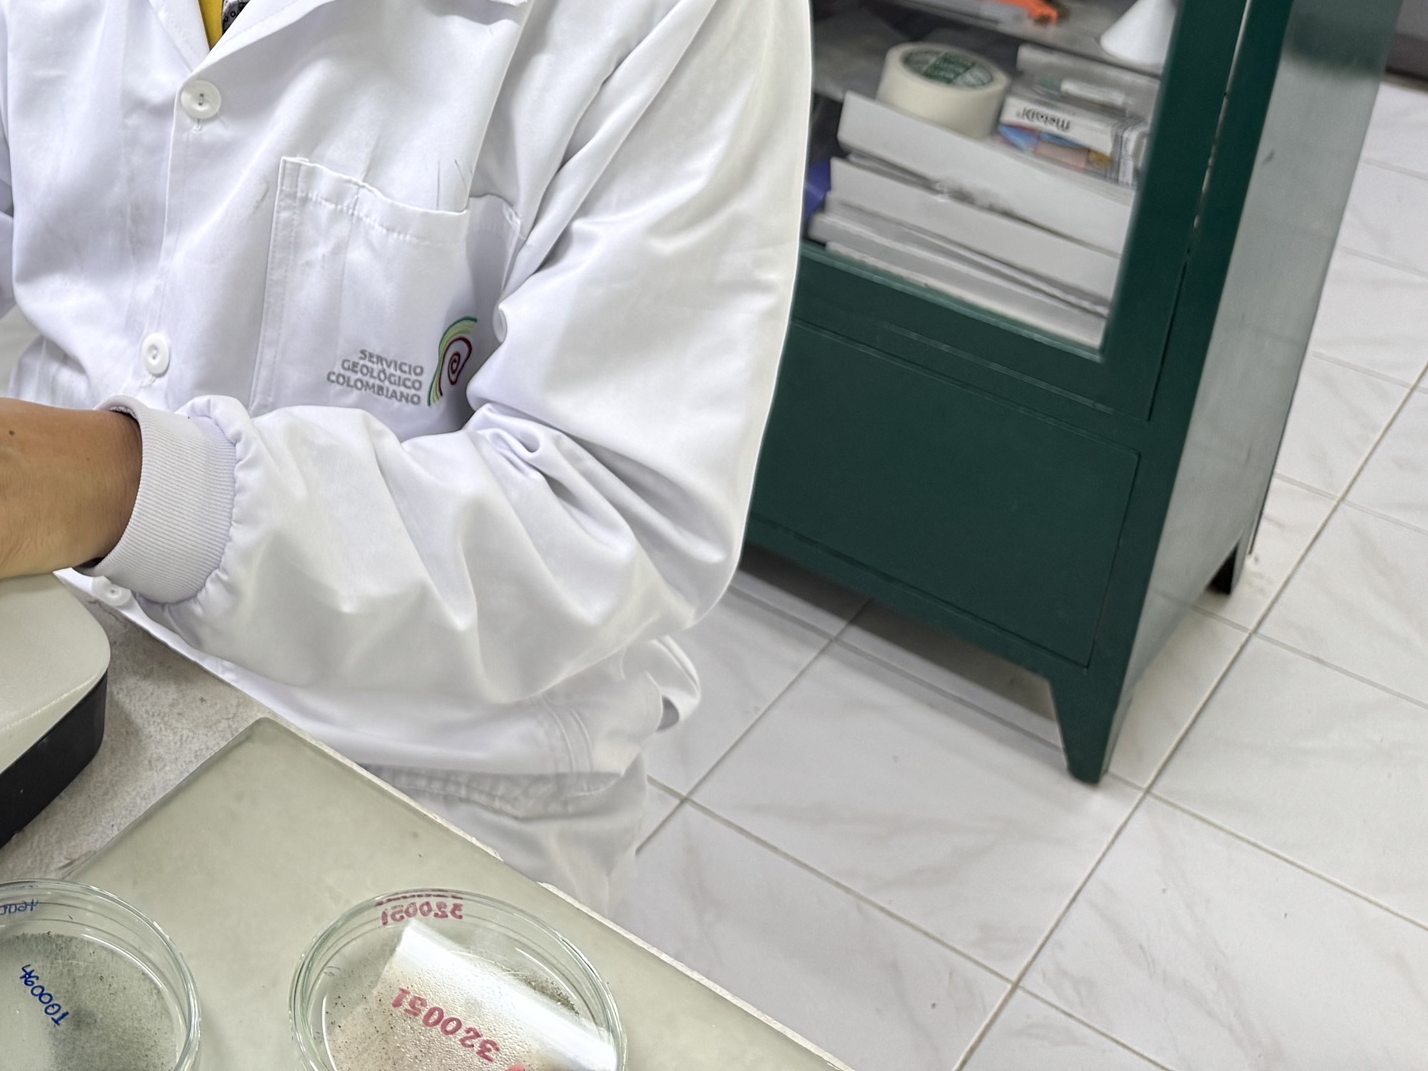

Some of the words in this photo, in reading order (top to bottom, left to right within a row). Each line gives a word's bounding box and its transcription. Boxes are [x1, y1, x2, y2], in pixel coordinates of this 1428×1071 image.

[340, 358, 423, 391] GEOLÓGICO
[358, 348, 424, 377] SERVICIO
[326, 371, 422, 406] COLOMBIANO
[393, 989, 500, 1064] 320051
